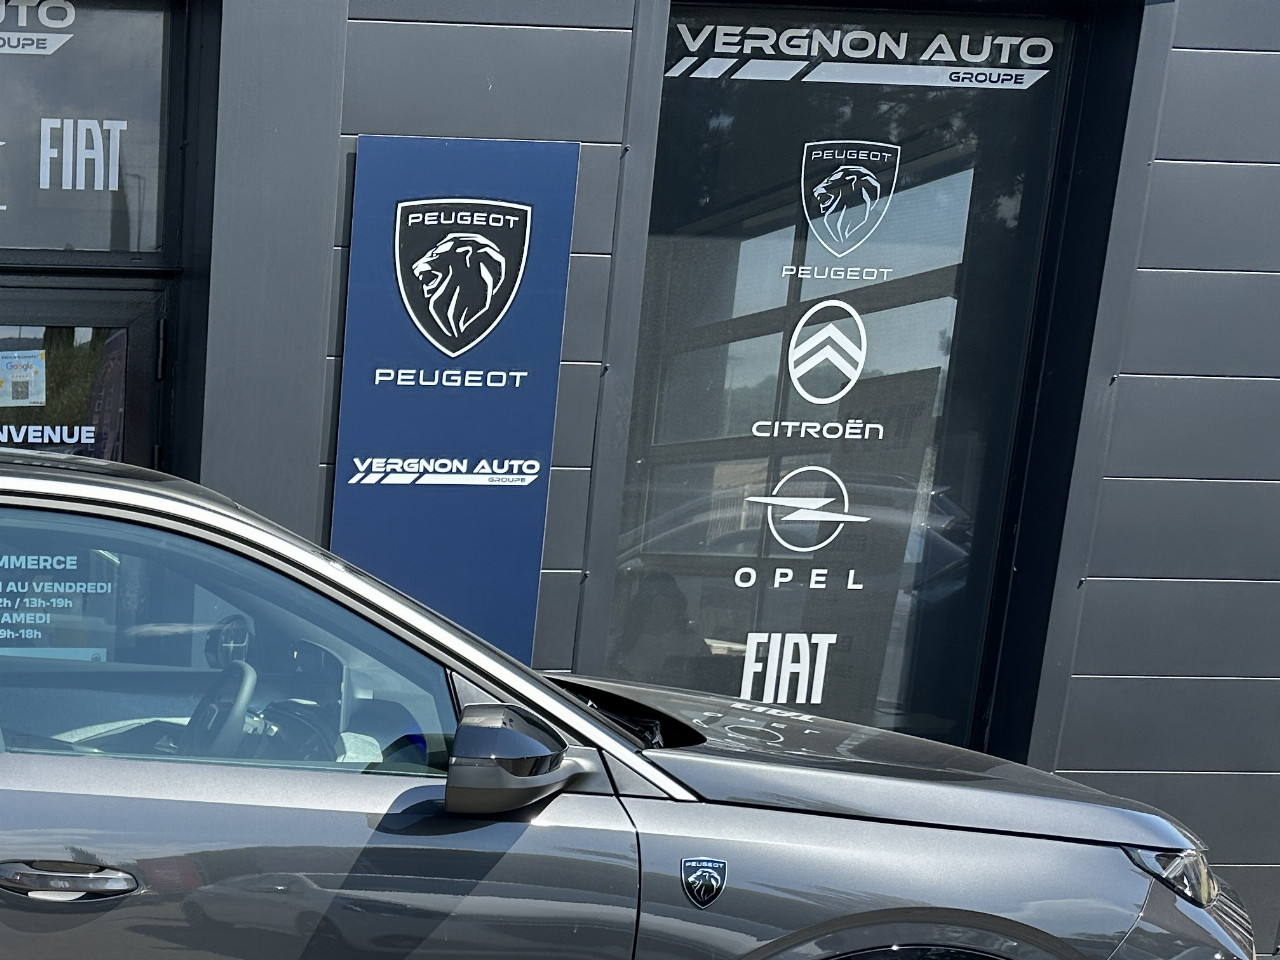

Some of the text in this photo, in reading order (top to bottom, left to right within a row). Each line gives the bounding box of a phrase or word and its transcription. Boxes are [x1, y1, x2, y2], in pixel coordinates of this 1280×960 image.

[677, 23, 1054, 65] VERGNON AUTO
[948, 71, 1025, 85] GROUPE
[39, 117, 128, 191] FIAT
[811, 149, 892, 162] PEUGEOT
[407, 211, 520, 229] PEUGEOT
[782, 265, 893, 281] PEUGEOT
[6, 361, 33, 372] Google
[374, 368, 529, 387] PEUGEOT
[352, 456, 541, 475] VERGNON AUTO
[734, 567, 864, 590] OPEL
[6, 581, 28, 593] AU
[32, 581, 112, 594] VENDREDI
[14, 597, 21, 609] /
[23, 597, 73, 608] 13h-19h
[739, 632, 838, 705] FIAT
[685, 861, 725, 869] PEUGEOT
